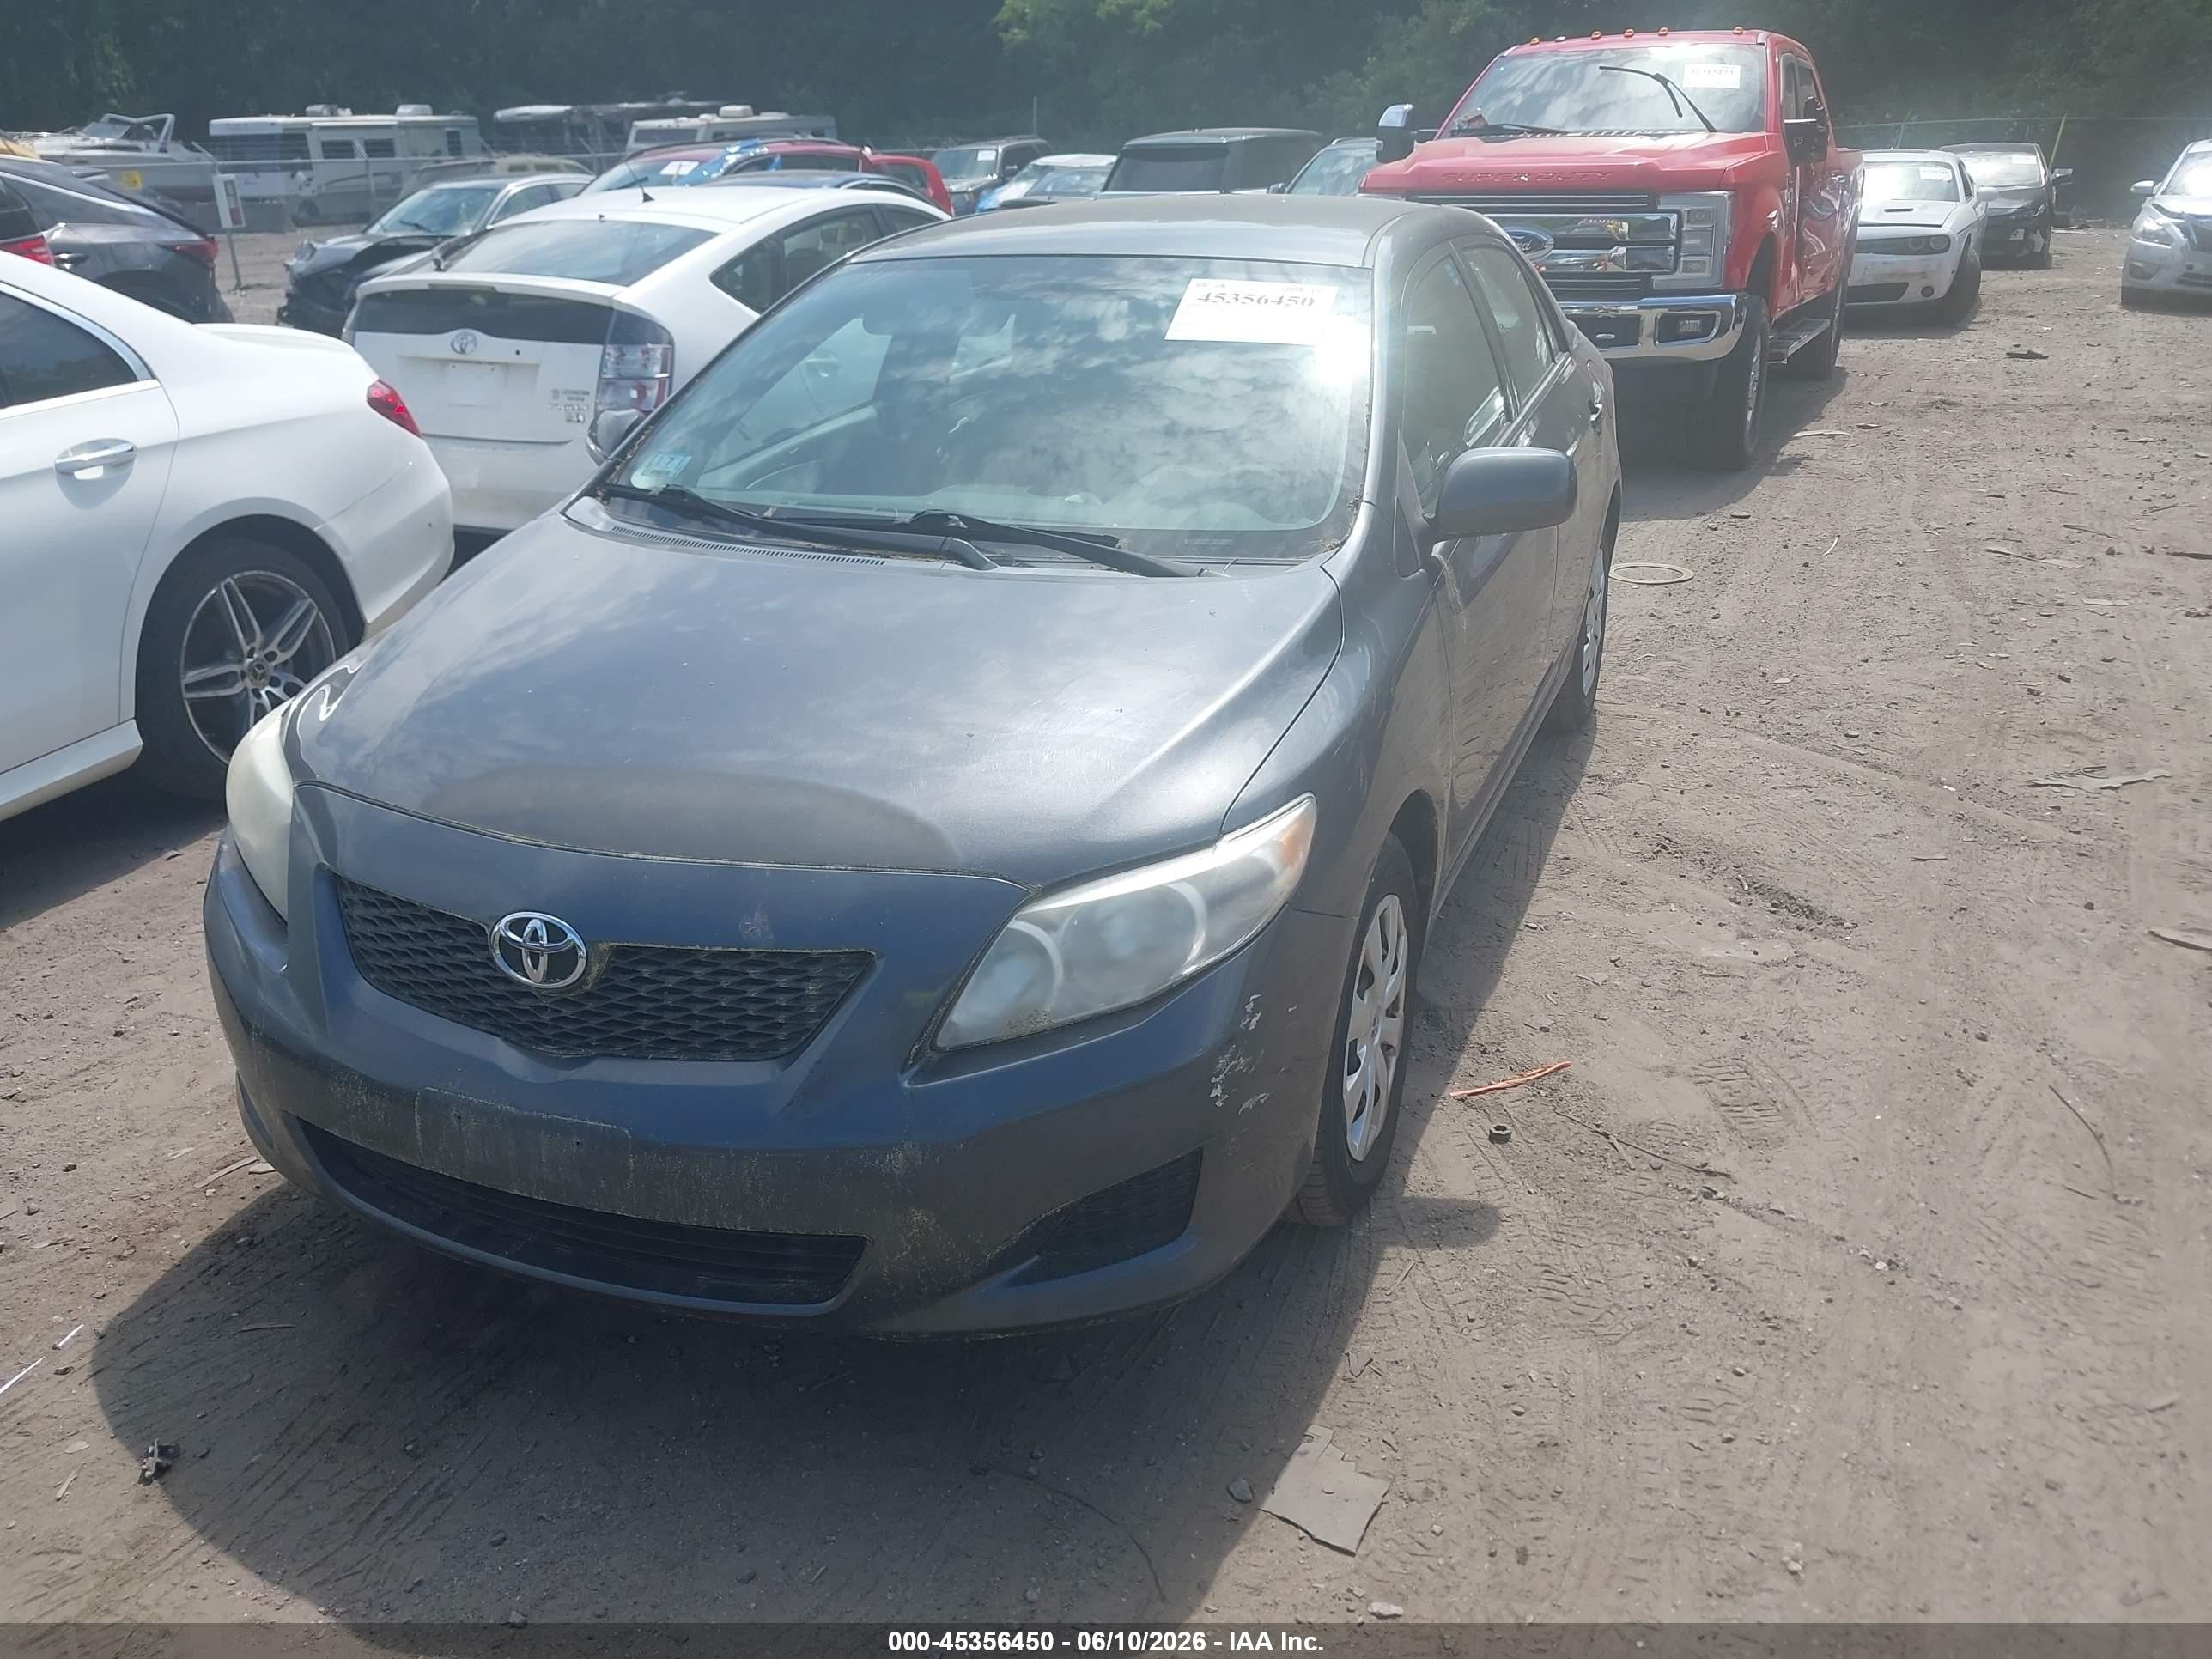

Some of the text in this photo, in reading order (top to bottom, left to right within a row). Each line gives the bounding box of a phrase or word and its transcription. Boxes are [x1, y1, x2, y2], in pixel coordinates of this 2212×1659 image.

[1442, 171, 1614, 182] SUPER DUTY
[1197, 291, 1315, 307] 45356450
